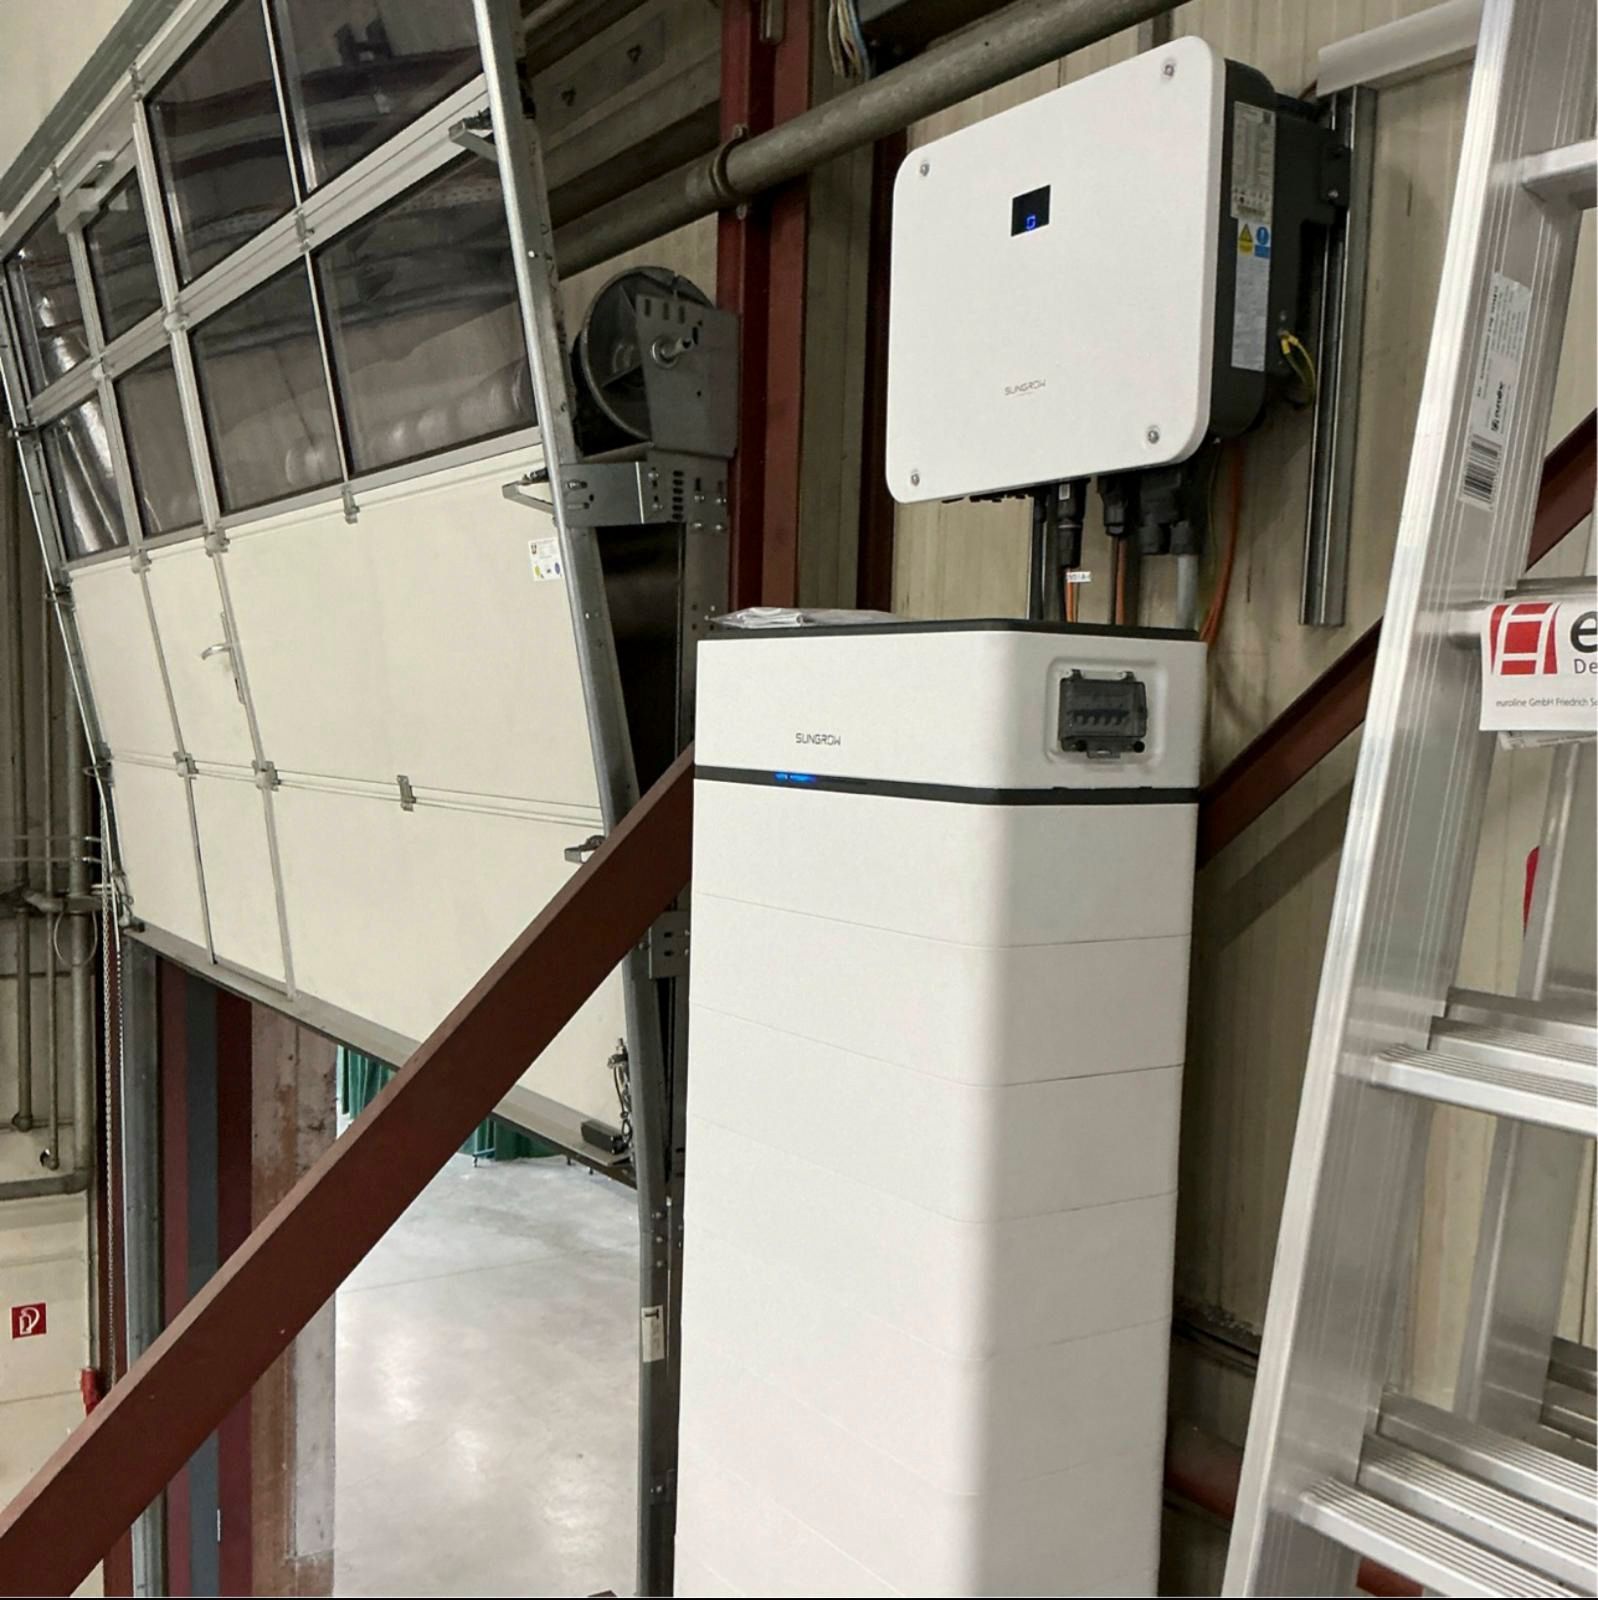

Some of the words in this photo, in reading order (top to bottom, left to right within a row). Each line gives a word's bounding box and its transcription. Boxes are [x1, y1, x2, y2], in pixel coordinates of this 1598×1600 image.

[1004, 379, 1047, 396] SUNGROW
[1495, 697, 1527, 708] euroline
[1528, 697, 1555, 708] GmbH
[1556, 697, 1589, 707] Friedrich
[795, 732, 842, 747] SUNGROW
